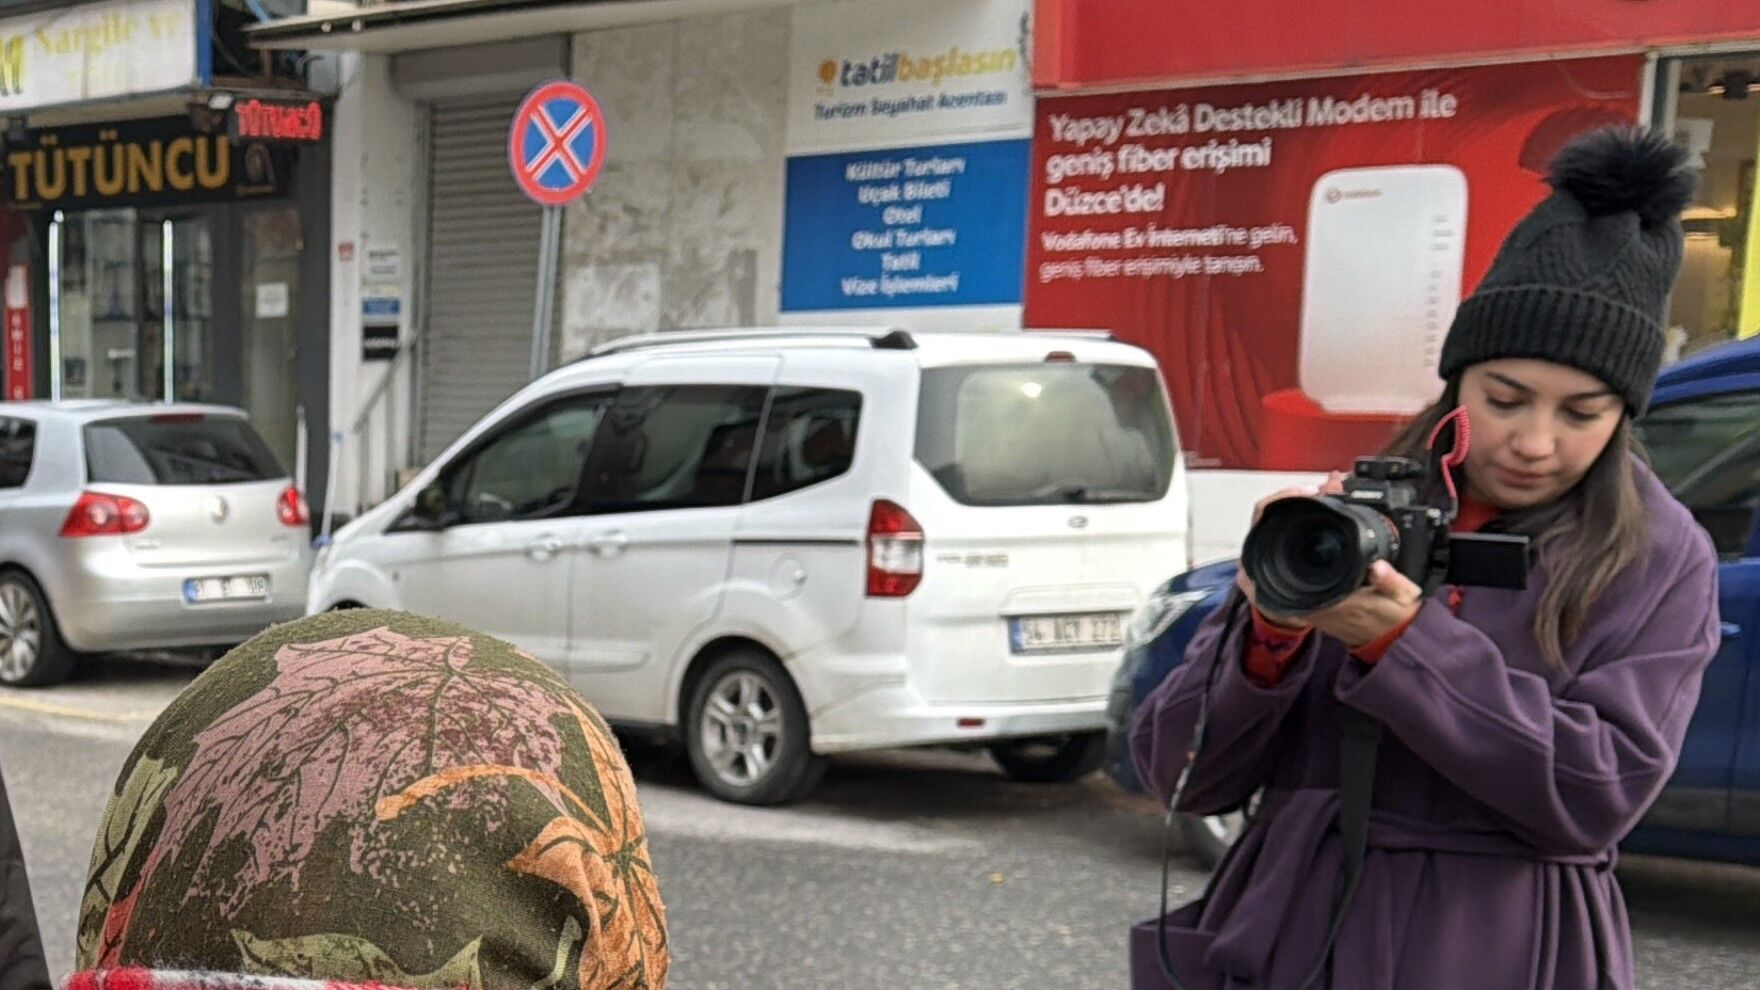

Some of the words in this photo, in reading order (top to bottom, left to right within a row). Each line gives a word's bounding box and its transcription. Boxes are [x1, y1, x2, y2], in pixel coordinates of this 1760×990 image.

[1049, 112, 1124, 146] Yapay
[1194, 97, 1302, 132] Destekli
[1306, 92, 1415, 126] Modem
[1418, 87, 1457, 119] ile
[846, 161, 902, 181] Kültür
[1046, 147, 1114, 184] geniş
[1117, 143, 1180, 174] fiber
[1181, 136, 1272, 174] erişimi
[858, 185, 900, 205] Uçak
[903, 178, 951, 200] Bileti
[1044, 182, 1166, 217] Düzce'de!
[883, 204, 922, 225] Otel
[852, 230, 893, 250] Okul
[1041, 229, 1122, 251] Vodafone
[1123, 227, 1146, 249] Ev
[1249, 223, 1299, 250] gelin.
[881, 251, 921, 271] Tatil
[1040, 257, 1083, 284] geniş
[842, 277, 878, 296] Vize
